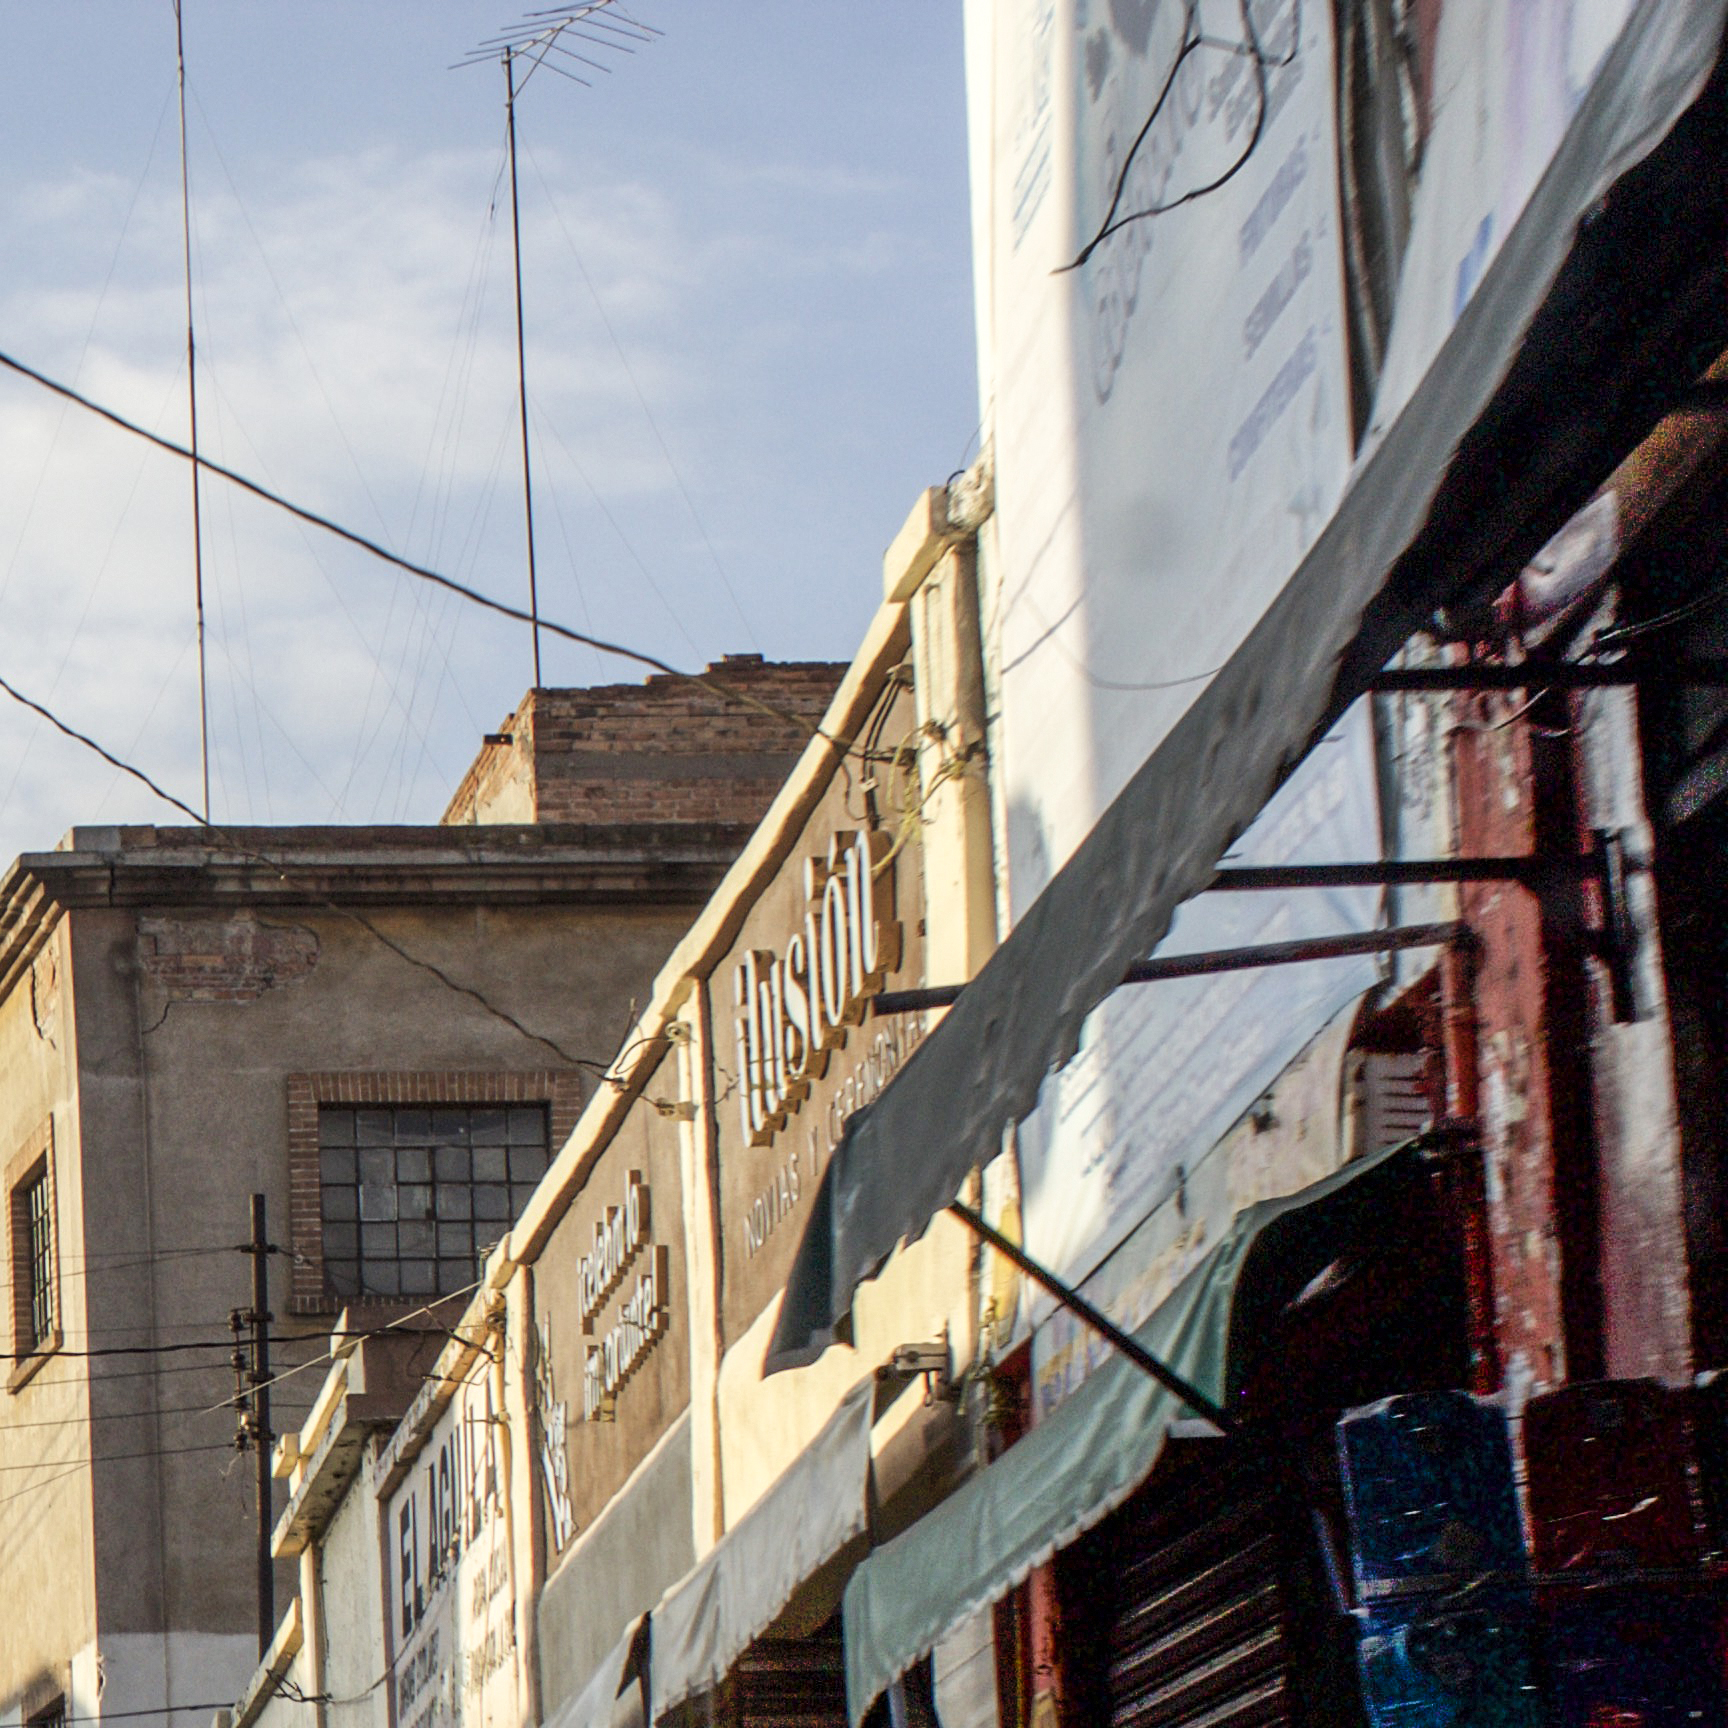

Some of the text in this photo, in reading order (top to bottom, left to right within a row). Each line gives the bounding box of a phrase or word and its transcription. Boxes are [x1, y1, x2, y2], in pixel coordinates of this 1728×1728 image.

[733, 829, 881, 1149] ilusión
[744, 1152, 801, 1258] NOVIAS
[807, 1125, 819, 1176] Y
[400, 1492, 425, 1640] EL
[428, 1382, 502, 1590] AGUILA
